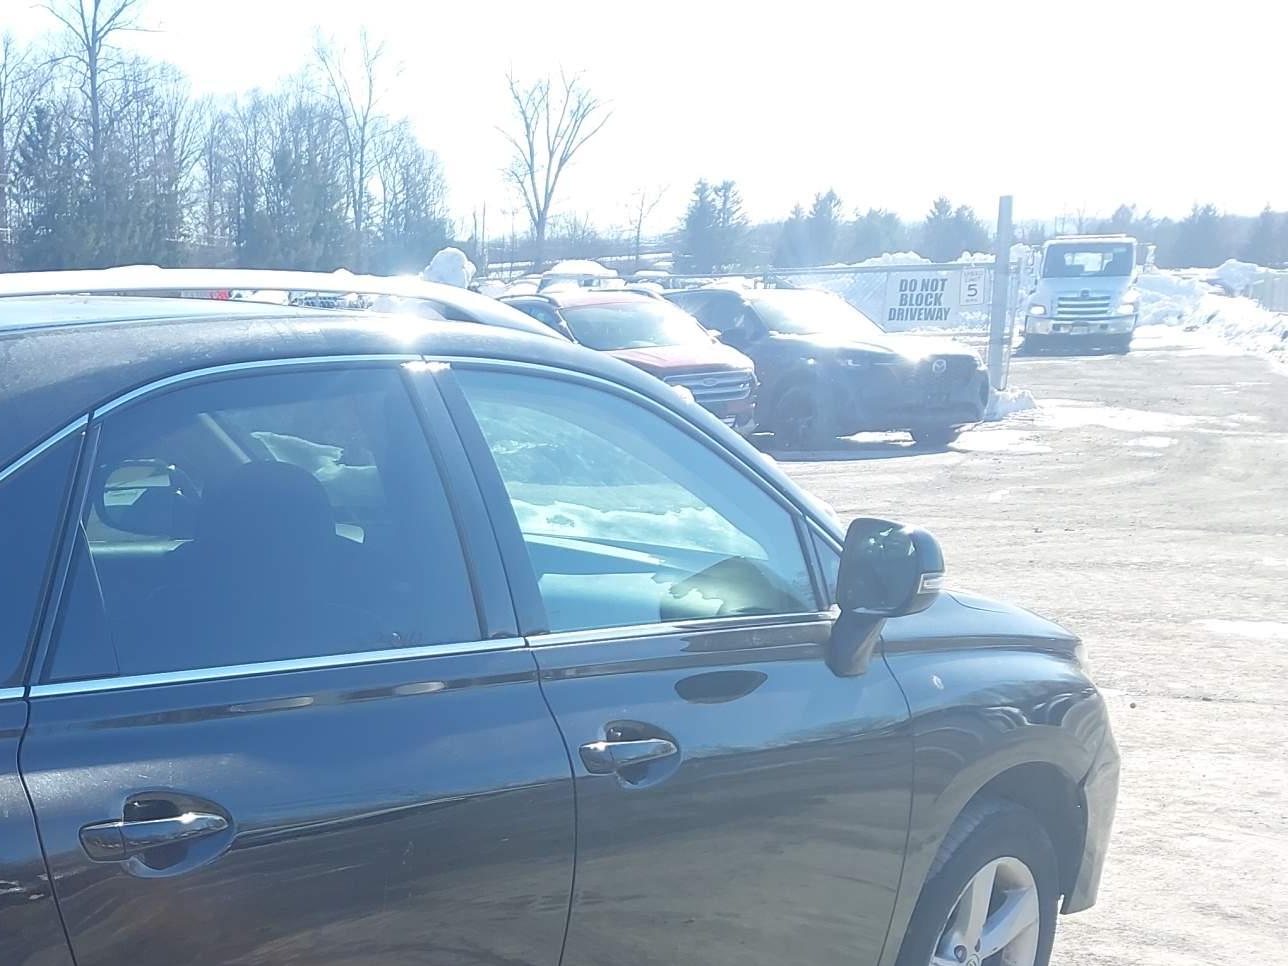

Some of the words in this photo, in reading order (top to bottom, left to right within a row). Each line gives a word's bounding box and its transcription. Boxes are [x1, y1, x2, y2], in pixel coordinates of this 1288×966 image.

[899, 278, 918, 292] DO
[920, 278, 948, 292] NOT
[967, 283, 978, 297] 5
[899, 293, 943, 307] BLOCK
[888, 307, 951, 321] DRIVEWAY
